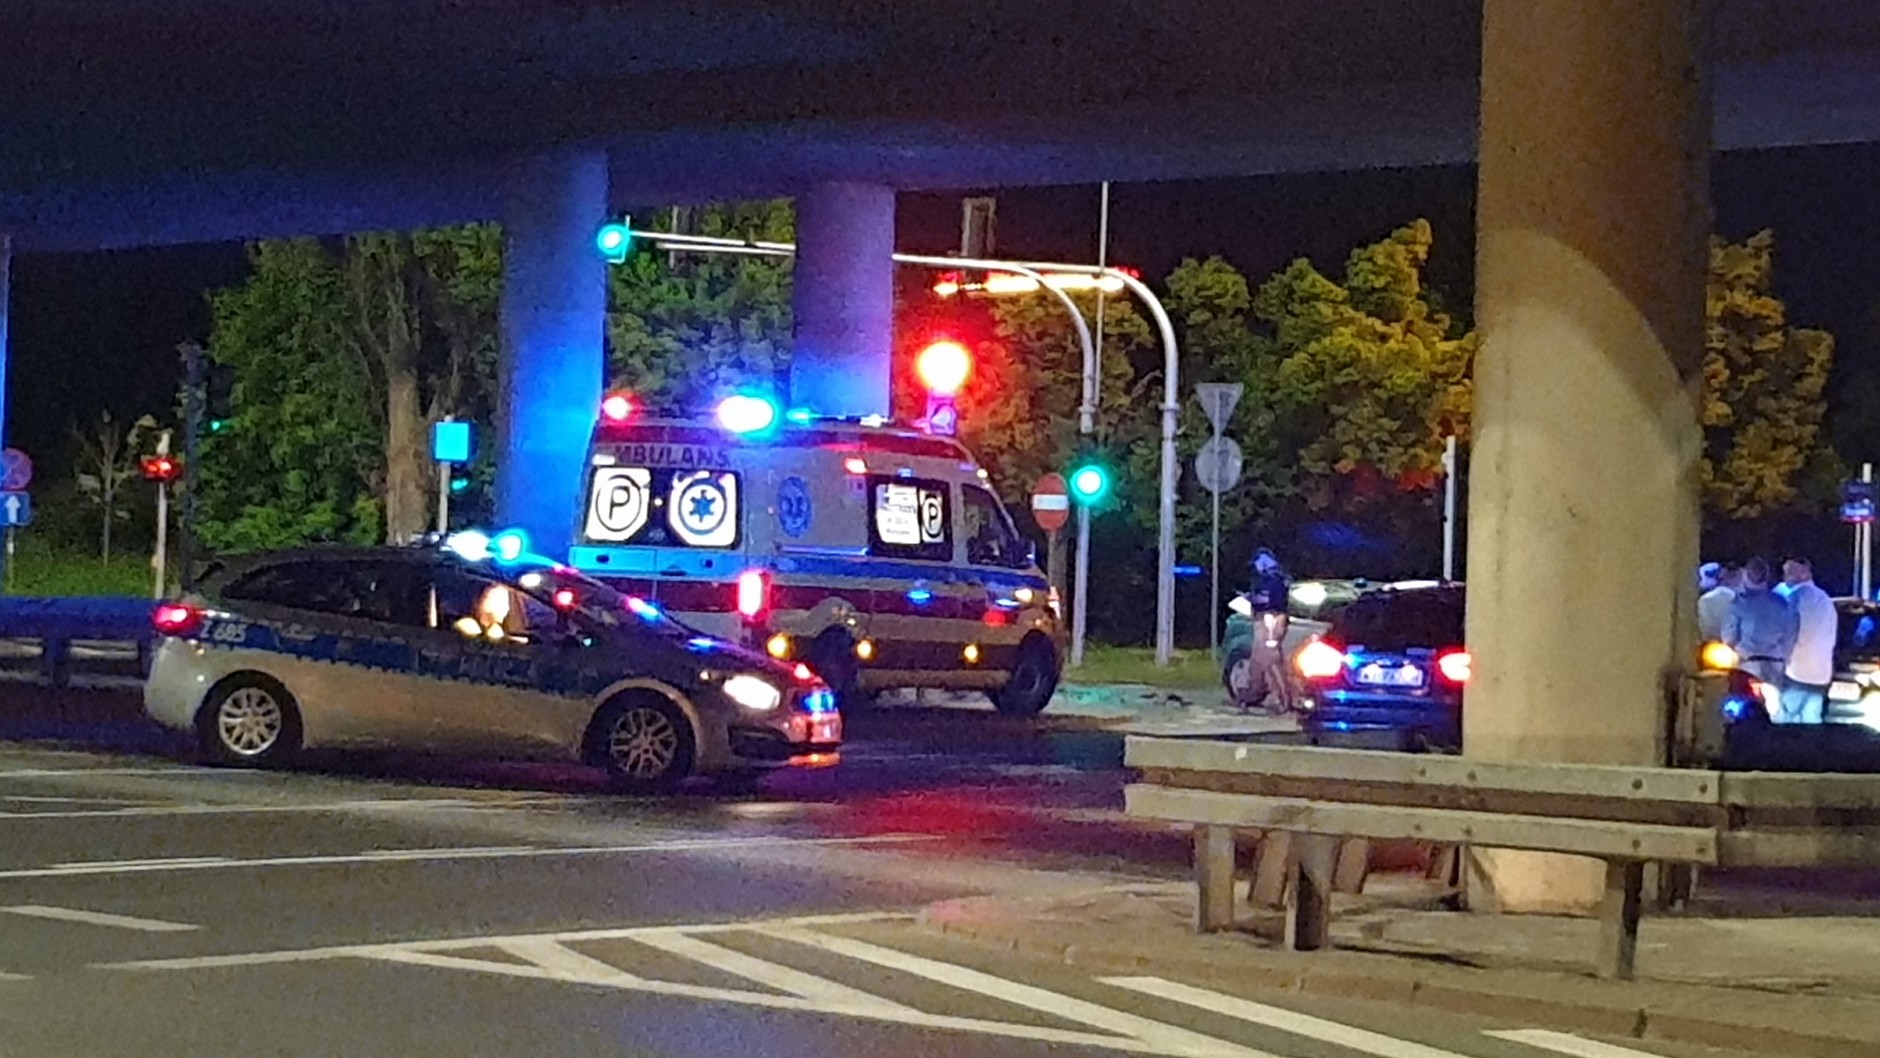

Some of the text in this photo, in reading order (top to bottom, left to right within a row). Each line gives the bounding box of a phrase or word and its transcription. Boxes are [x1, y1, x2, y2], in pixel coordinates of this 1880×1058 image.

[610, 444, 731, 468] MBULANS
[608, 485, 631, 521] P
[928, 501, 939, 531] P
